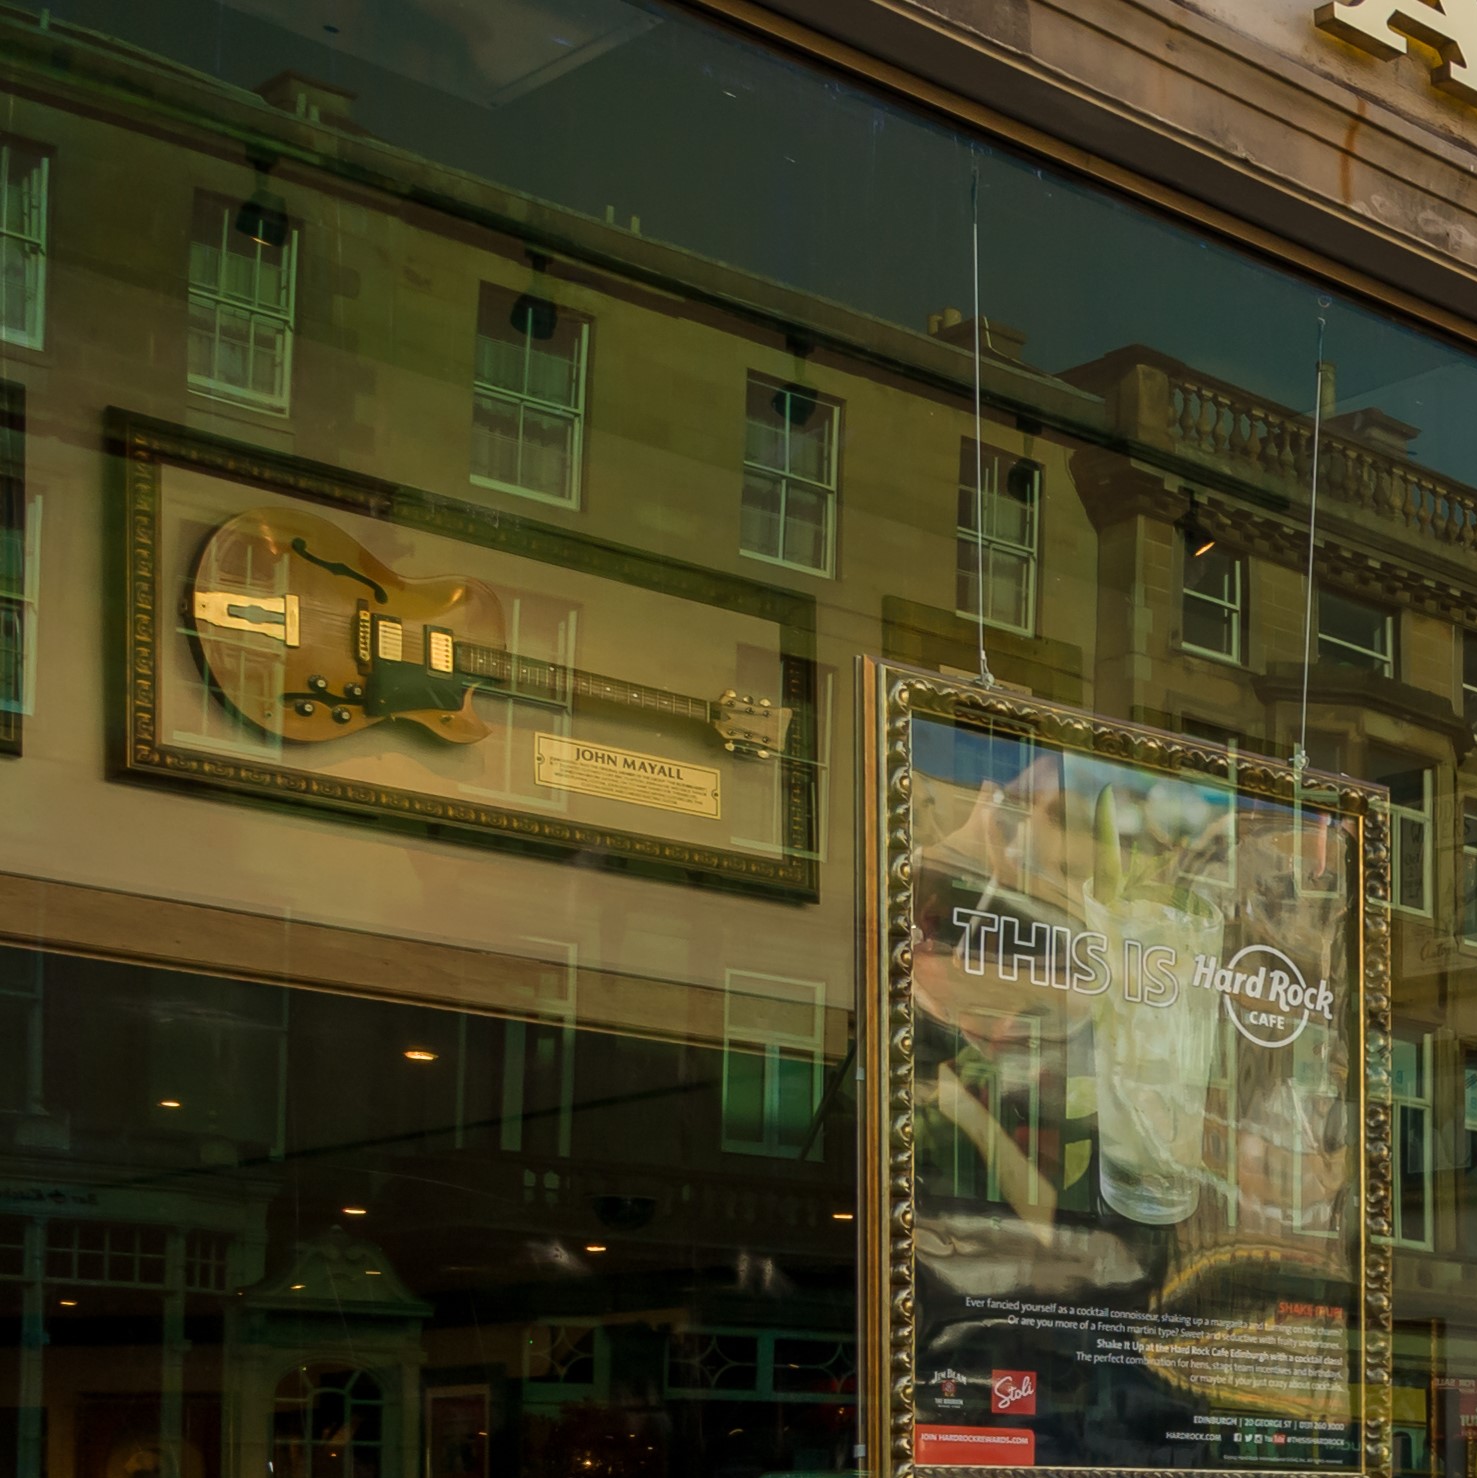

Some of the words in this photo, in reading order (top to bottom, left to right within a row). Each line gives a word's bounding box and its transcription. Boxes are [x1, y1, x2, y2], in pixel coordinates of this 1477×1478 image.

[575, 747, 618, 766] JOHN
[622, 757, 684, 781] MAYALL
[952, 907, 1112, 995] THIS
[1123, 940, 1180, 1008] IS
[1192, 951, 1264, 999] Hard
[1269, 968, 1334, 1020] Rock
[1248, 1010, 1285, 1030] CAFE
[965, 1296, 986, 1308] Ever
[987, 1298, 1020, 1310] fancied
[1020, 1301, 1057, 1314] yourself
[1057, 1306, 1068, 1314] as
[1069, 1307, 1075, 1315] a
[1076, 1306, 1110, 1318] cocktail
[1161, 1313, 1192, 1327] shaking
[1193, 1317, 1203, 1327] up
[1211, 1318, 1249, 1331] margarita
[1249, 1321, 1264, 1331] and
[1303, 1326, 1316, 1335] the
[1007, 1314, 1019, 1325] Or
[1020, 1317, 1035, 1326] are
[1036, 1318, 1054, 1329] you
[1054, 1319, 1078, 1330] more
[1079, 1319, 1090, 1331] of
[1097, 1321, 1126, 1333] French
[1126, 1324, 1156, 1335] martini
[1158, 1327, 1180, 1338] type?
[1181, 1328, 1205, 1340] Sweet
[1206, 1330, 1221, 1341] and
[1222, 1332, 1258, 1345] seductive
[1259, 1335, 1277, 1345] with
[1277, 1336, 1297, 1349] fruity
[1298, 1338, 1343, 1350] undertones.
[1076, 1351, 1092, 1362] The
[1093, 1352, 1124, 1365] perfect
[1125, 1356, 1177, 1368] combination
[1177, 1358, 1190, 1368] for
[1190, 1359, 1212, 1370] hens,
[1234, 1364, 1255, 1374] team
[1255, 1364, 1292, 1376] incentives
[1293, 1367, 1308, 1377] and
[1096, 1338, 1122, 1350] Shake
[1123, 1339, 1131, 1350] It
[1132, 1340, 1144, 1353] Up
[1145, 1342, 1154, 1351] at
[1155, 1344, 1170, 1354] the
[1170, 1344, 1191, 1355] Hard
[1191, 1345, 1210, 1356] Rock
[1211, 1347, 1229, 1358] Cafe
[1230, 1348, 1270, 1362] Edinburgh
[1270, 1352, 1288, 1363] with
[1295, 1354, 1323, 1365] cocktail
[994, 1376, 1034, 1409] Stoli
[1190, 1375, 1200, 1383] or
[1200, 1374, 1228, 1387] maybe
[1235, 1377, 1252, 1388] your
[1252, 1377, 1267, 1388] just
[1268, 1380, 1288, 1391] crazy
[1288, 1379, 1311, 1390] about
[1193, 1415, 1237, 1426] EDINBURGH
[1244, 1417, 1253, 1427] 20
[1254, 1418, 1282, 1428] GEORGE
[1283, 1419, 1293, 1429] ST
[921, 1433, 937, 1441] JOIN
[938, 1433, 1029, 1445] HARDROCKREWARDS.COM
[1165, 1431, 1222, 1442] HARDROCK.COM
